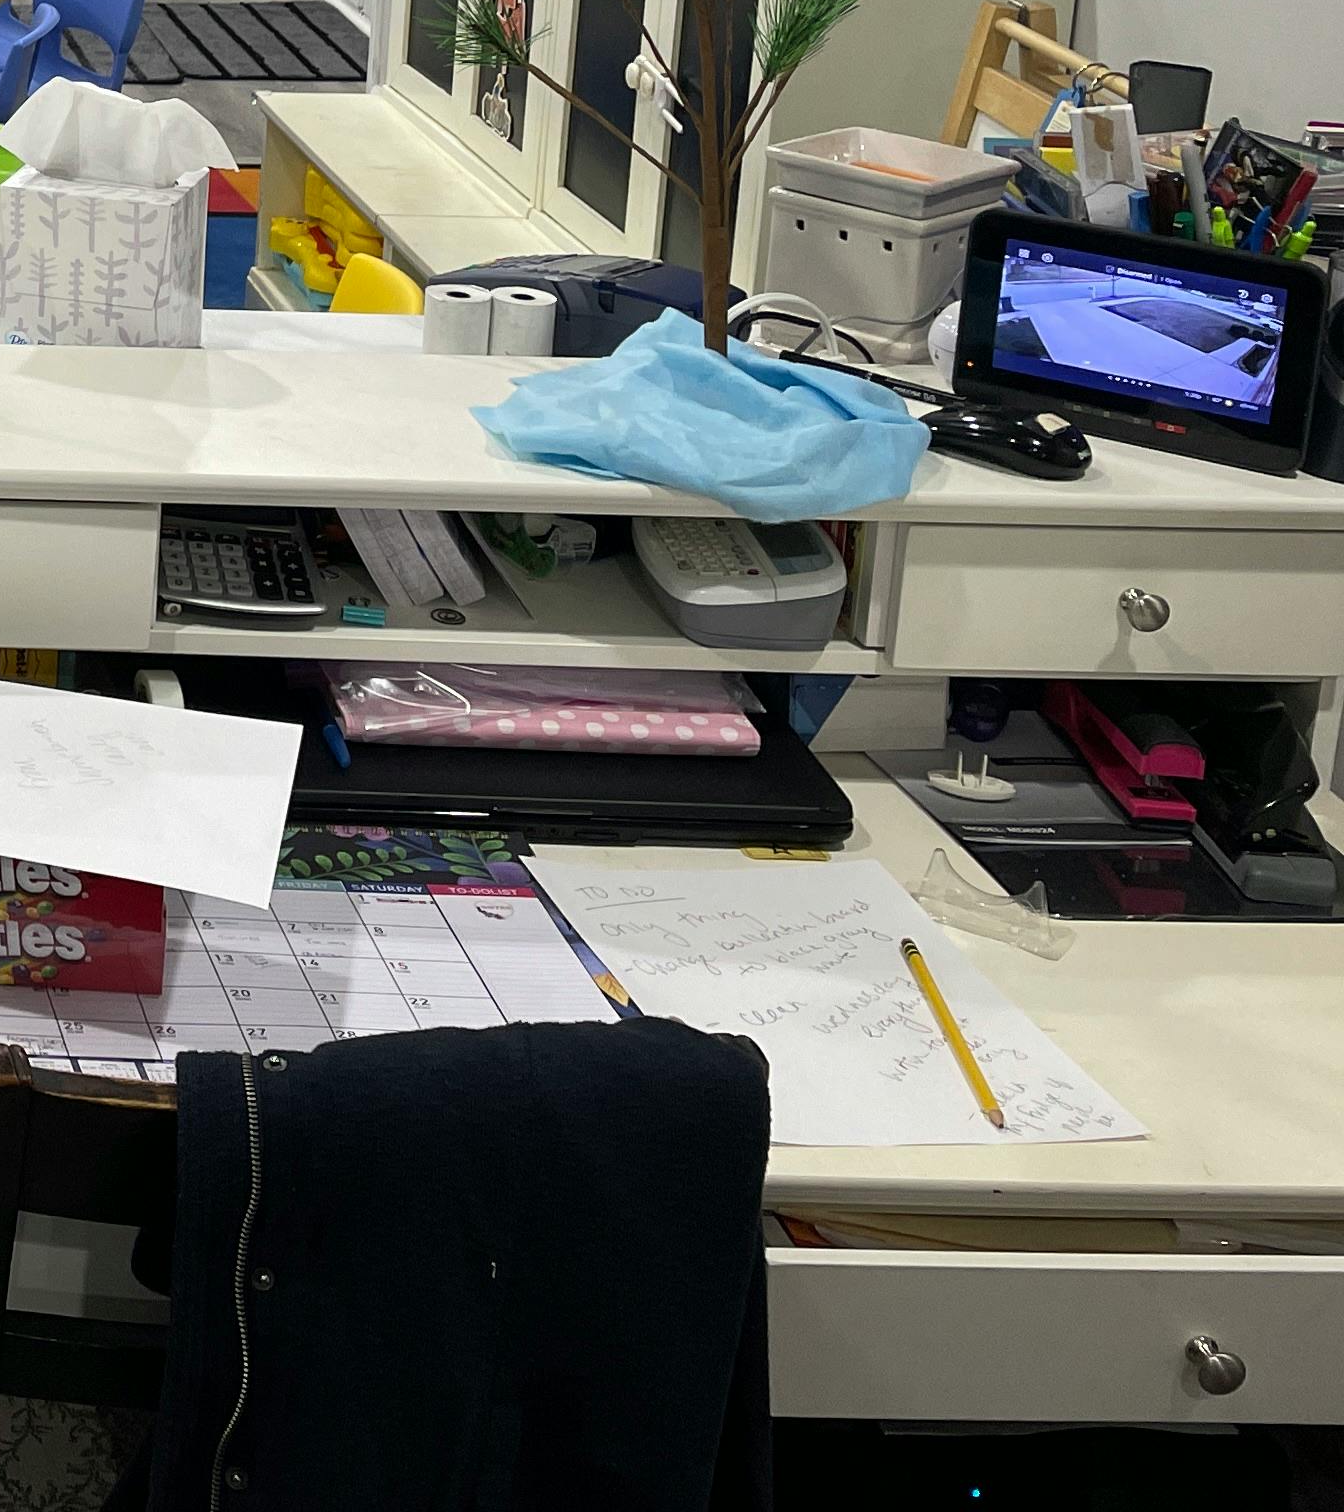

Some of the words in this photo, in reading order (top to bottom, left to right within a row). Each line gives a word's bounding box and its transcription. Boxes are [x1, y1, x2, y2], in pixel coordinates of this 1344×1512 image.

[350, 884, 423, 894] SATURDAY
[215, 954, 234, 963] 13
[389, 962, 409, 971] 15
[230, 989, 251, 998] 20
[318, 993, 338, 1002] 21
[409, 997, 430, 1007] 22
[62, 1022, 84, 1031] 25
[154, 1025, 176, 1035] 26
[246, 1027, 266, 1037] 27
[336, 1030, 357, 1038] 28
